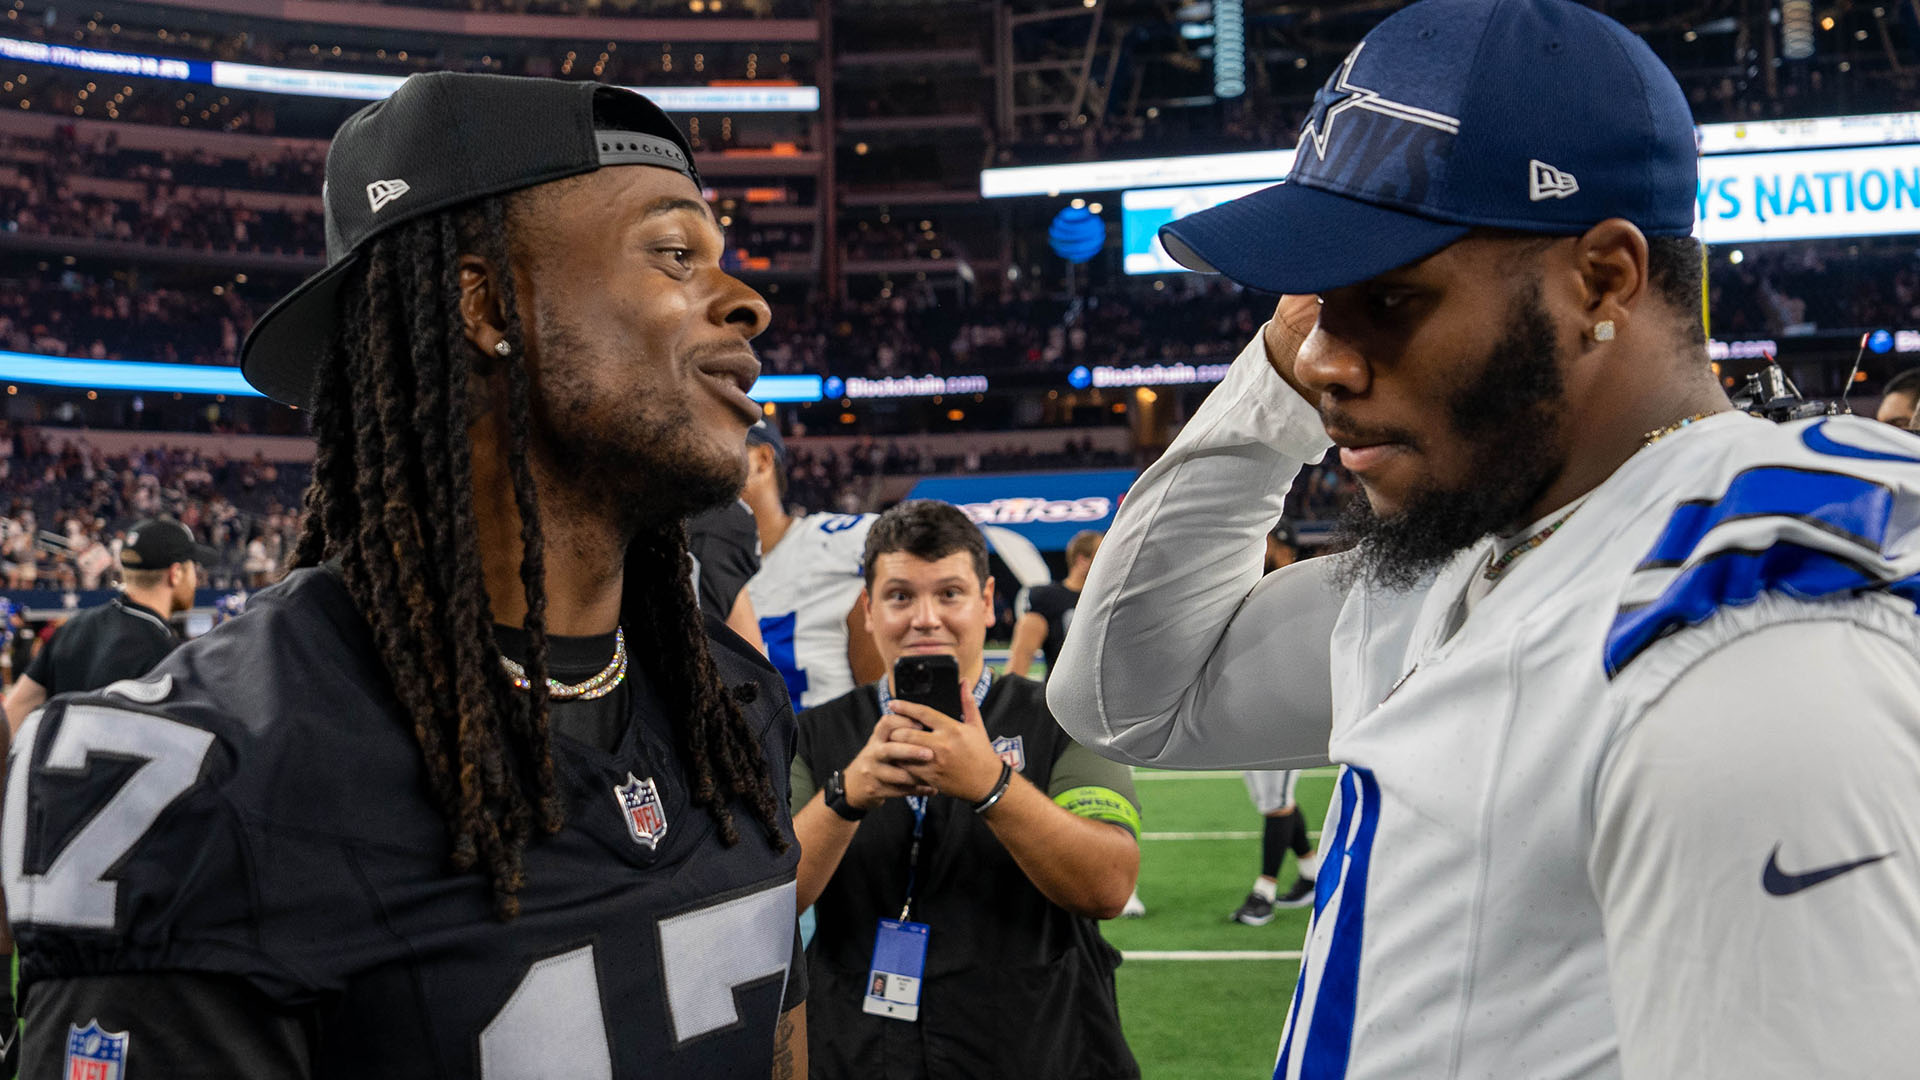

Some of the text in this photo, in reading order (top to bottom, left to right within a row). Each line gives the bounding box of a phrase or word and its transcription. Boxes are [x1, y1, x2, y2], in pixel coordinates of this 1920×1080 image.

[846, 374, 988, 398] Blockchain.com
[2, 703, 217, 930] 17
[631, 804, 662, 834] NFL
